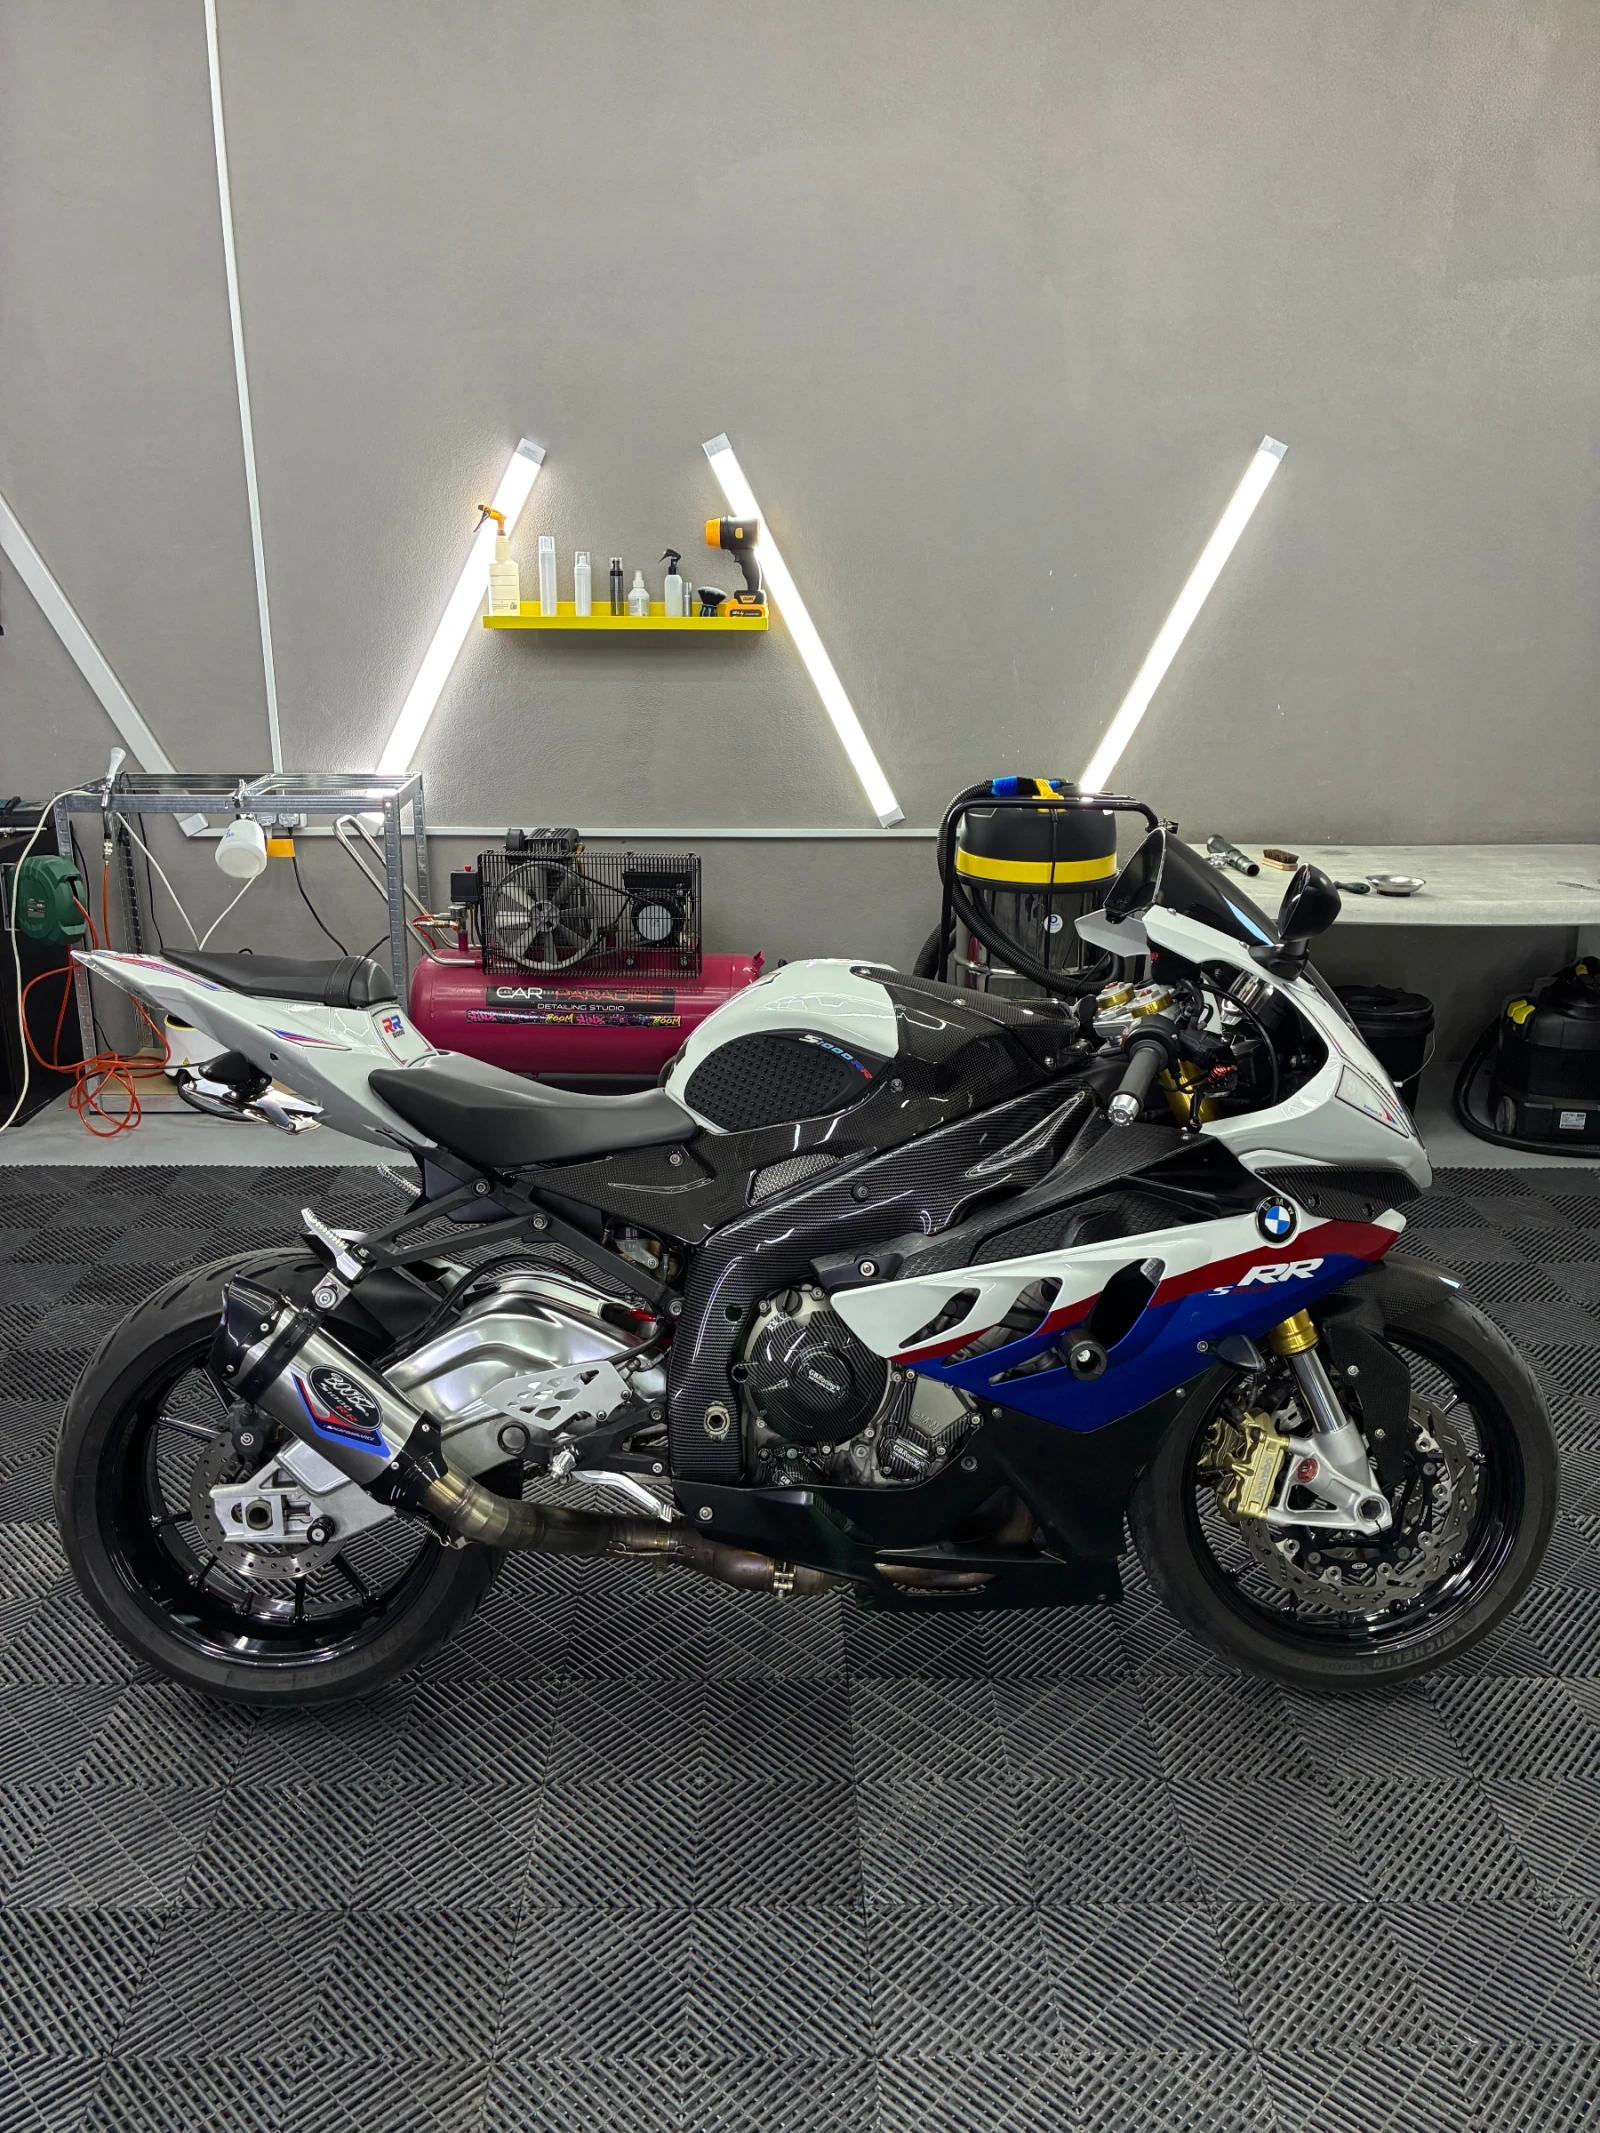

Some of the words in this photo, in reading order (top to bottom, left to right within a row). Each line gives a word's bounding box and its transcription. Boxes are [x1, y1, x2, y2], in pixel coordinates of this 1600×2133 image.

[496, 987, 543, 1000] CAR
[554, 989, 663, 1003] PARADISE
[537, 1003, 587, 1011] DETAILING
[589, 1004, 625, 1012] STUDIO
[382, 1015, 403, 1033] RR
[1261, 1197, 1295, 1215] BMW
[1237, 1257, 1325, 1287] RR
[911, 1410, 940, 1431] BMW
[1372, 1630, 1456, 1668] MICHELIN
